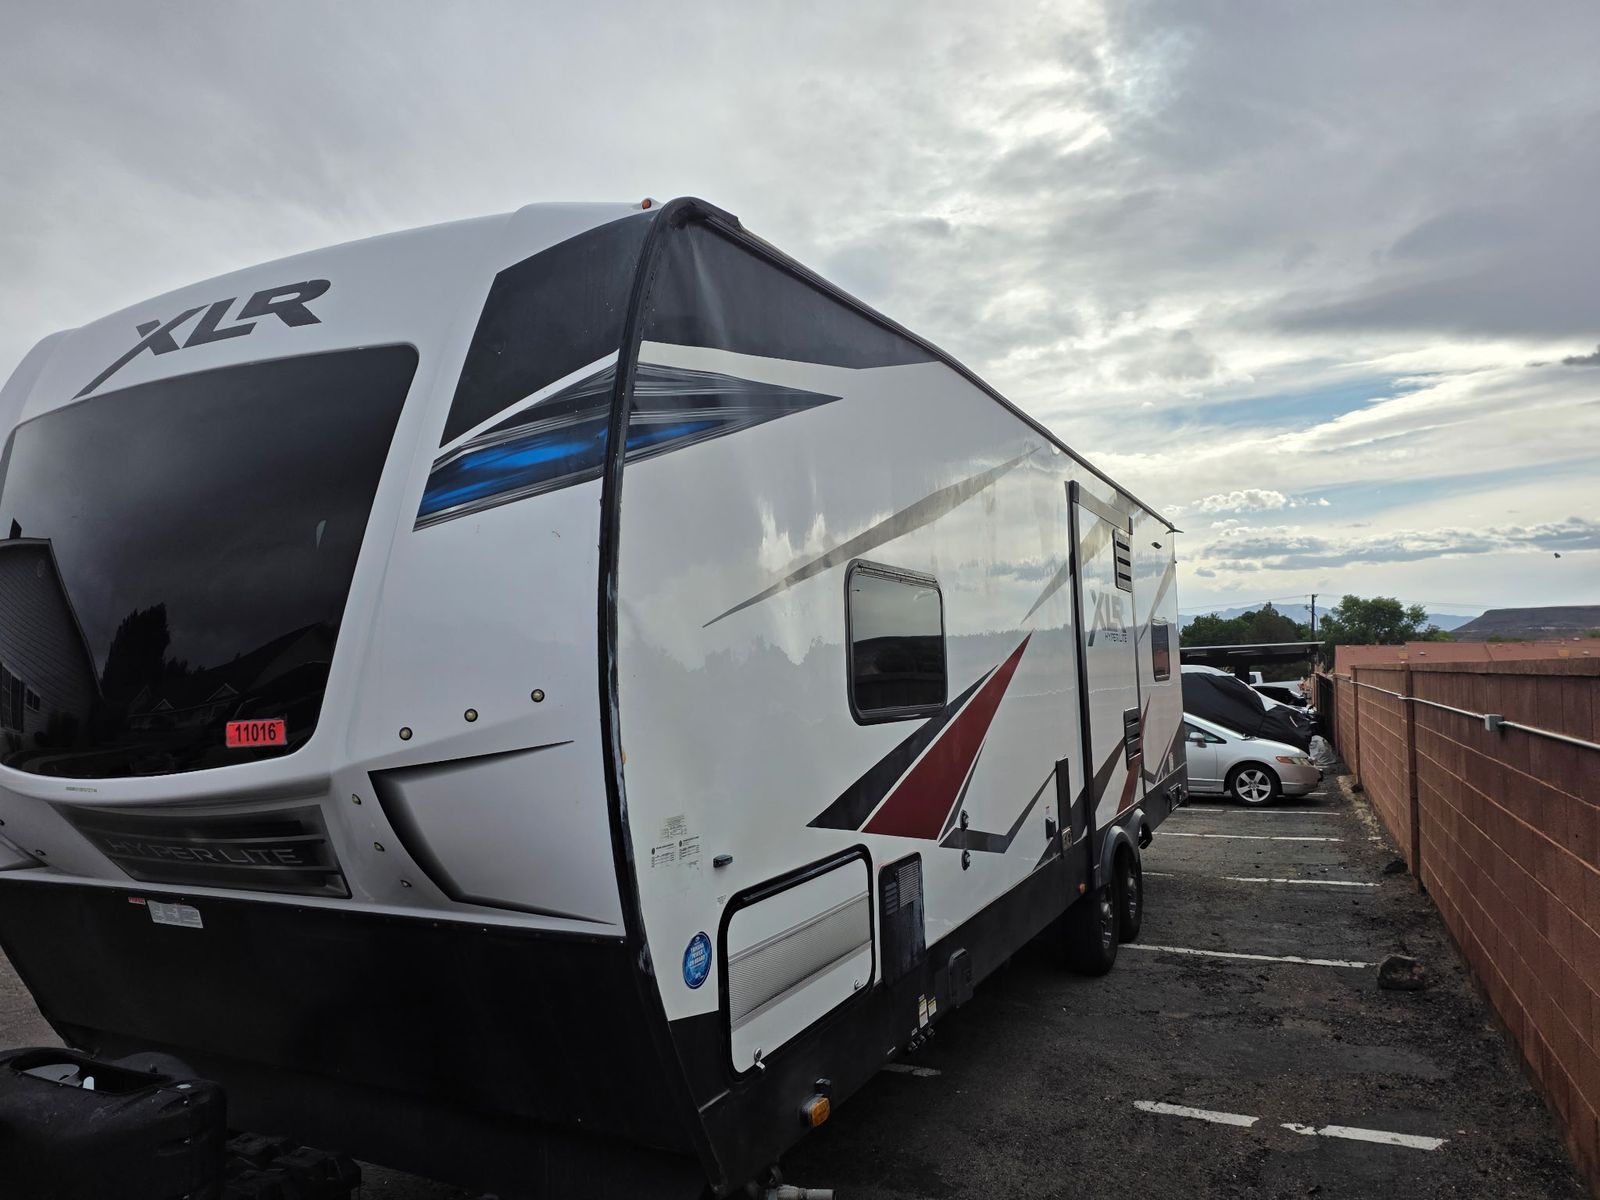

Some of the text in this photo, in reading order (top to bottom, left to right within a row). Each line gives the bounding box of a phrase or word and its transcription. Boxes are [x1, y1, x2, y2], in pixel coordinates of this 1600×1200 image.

[71, 279, 331, 400] XLR
[1088, 589, 1127, 646] XLR
[235, 722, 277, 742] 11016
[105, 838, 304, 864] HYPERLITE
